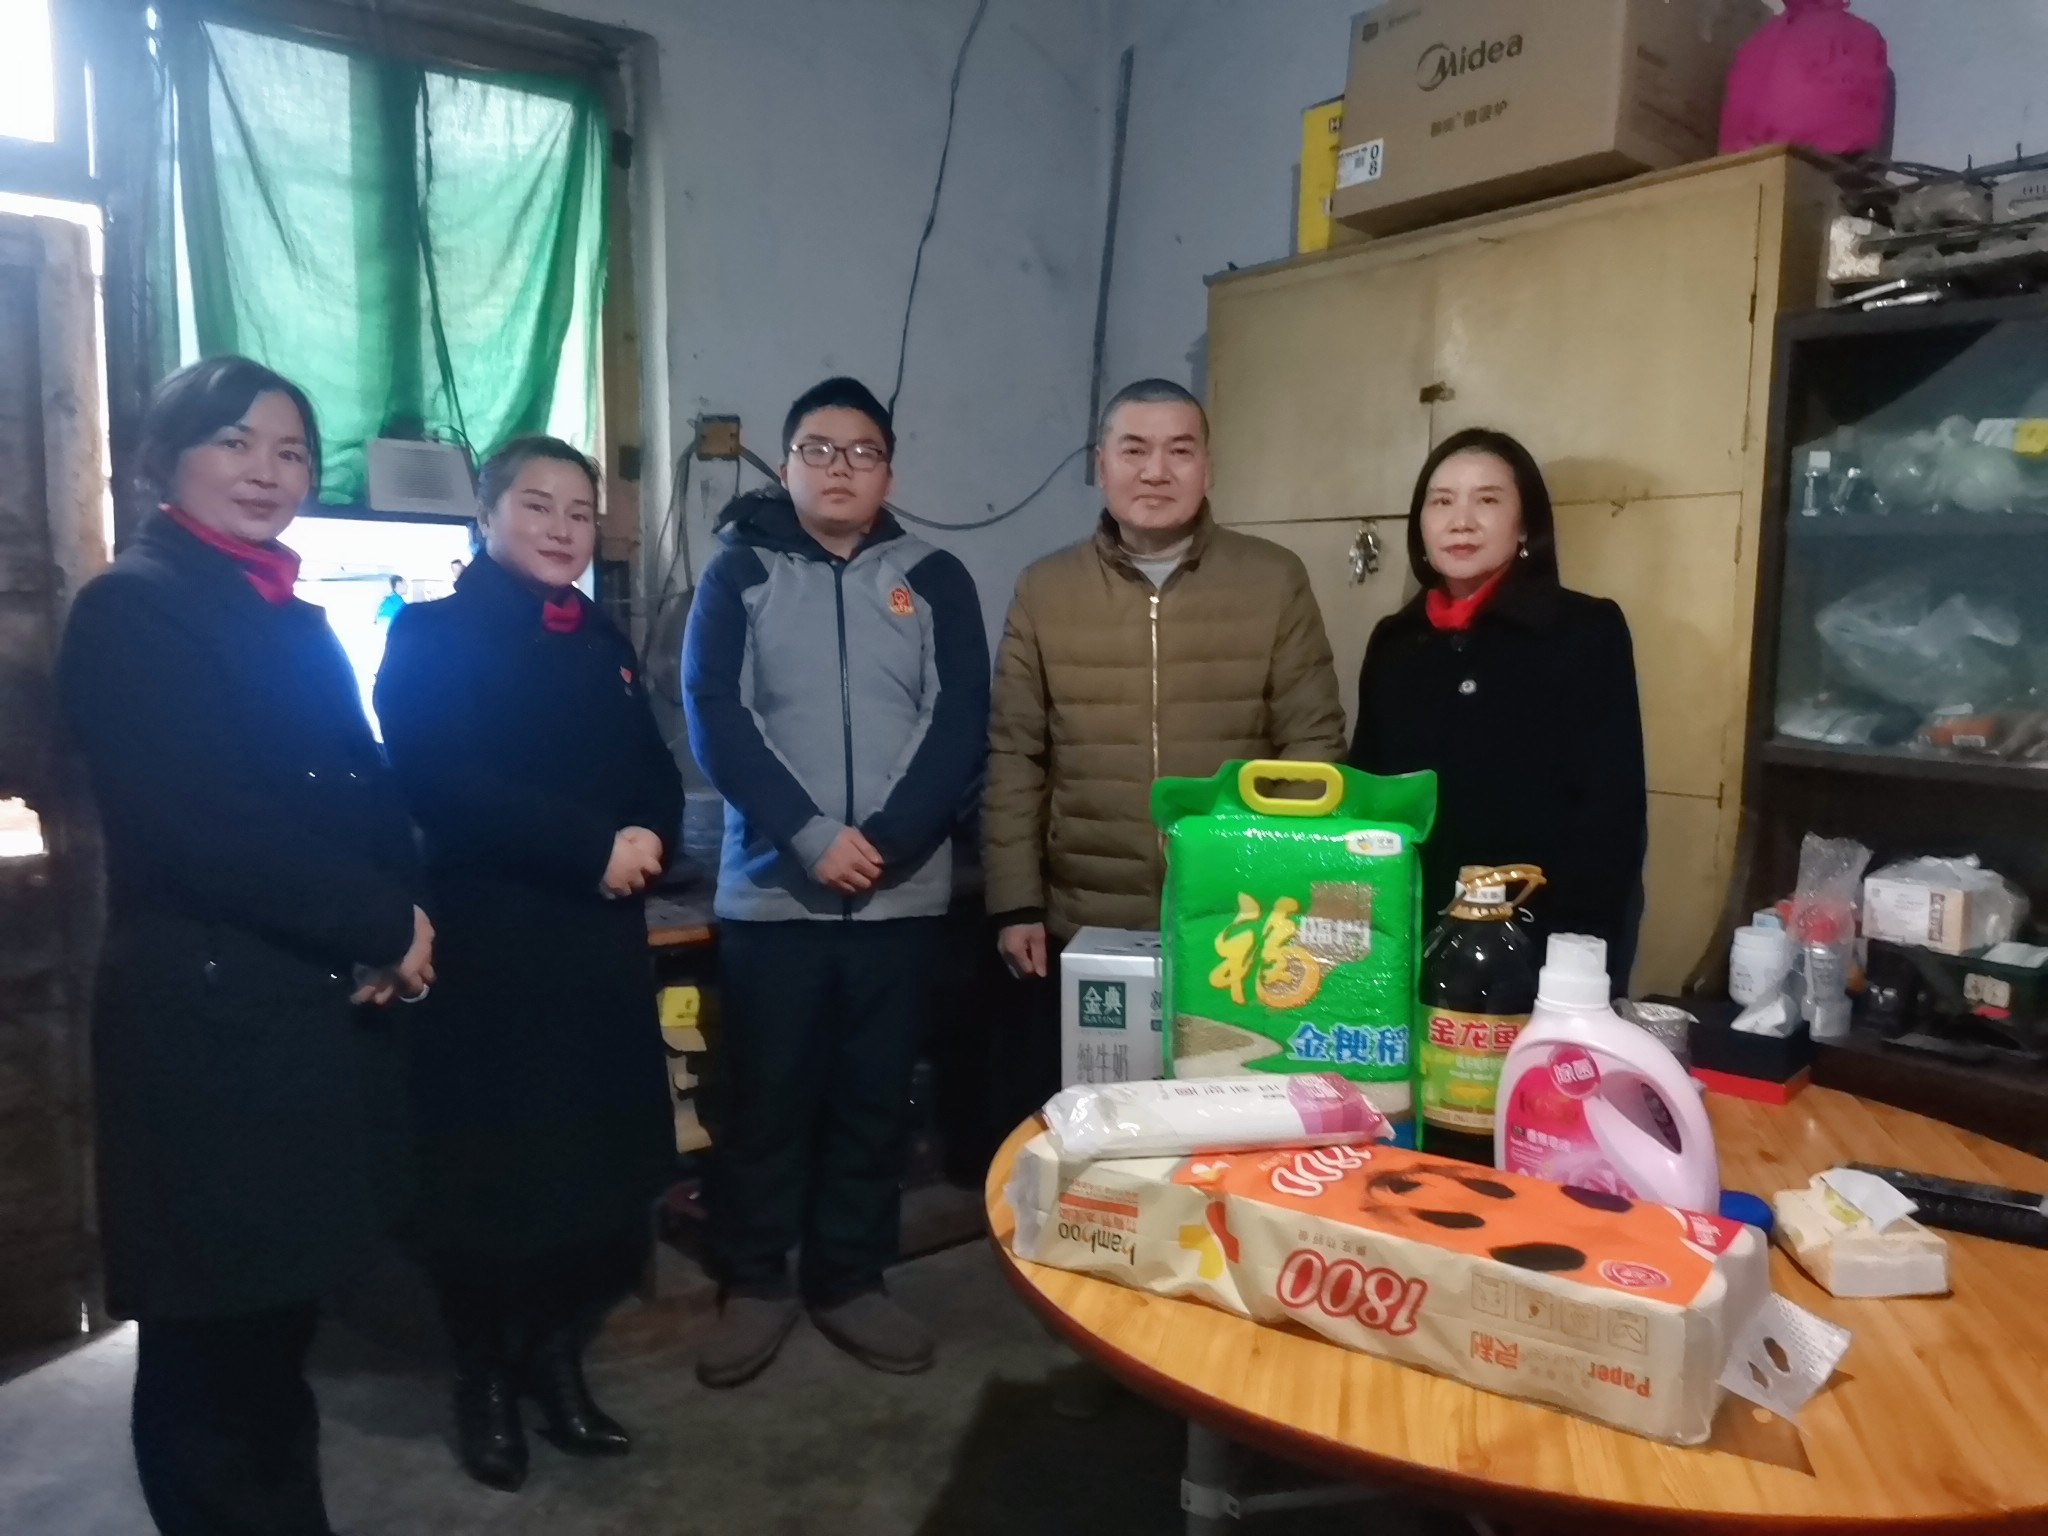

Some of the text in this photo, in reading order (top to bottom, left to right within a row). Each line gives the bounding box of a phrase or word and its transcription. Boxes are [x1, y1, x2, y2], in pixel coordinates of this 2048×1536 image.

[1416, 33, 1524, 92] Midea
[1082, 985, 1123, 1015] 金典
[1429, 1015, 1520, 1050] 金龙鱼
[1276, 1248, 1428, 1336] 1800
[1587, 1361, 1651, 1398] Paper
